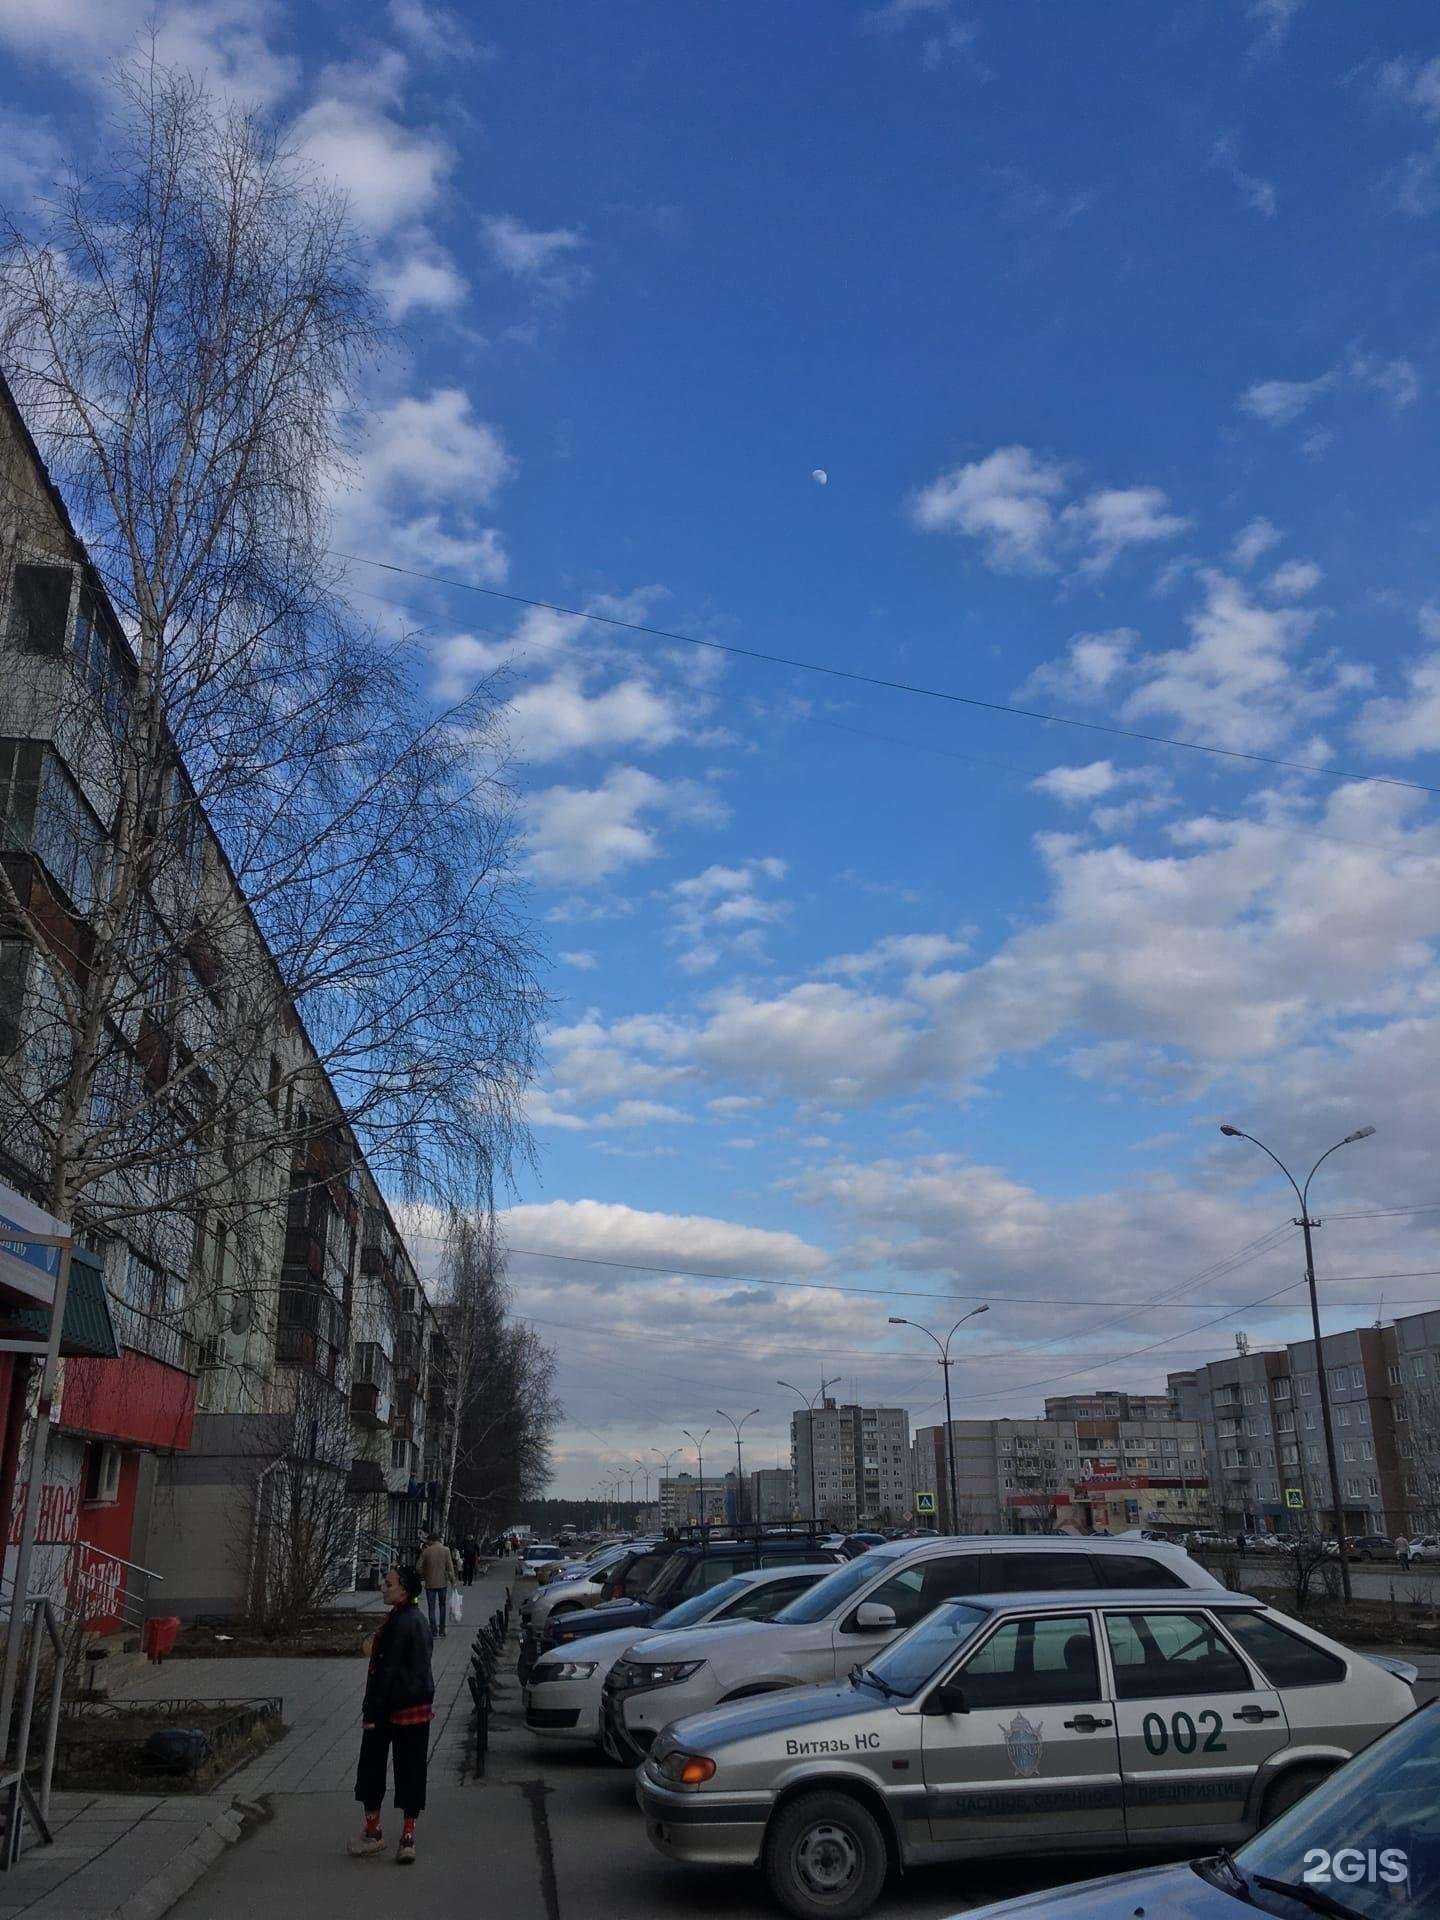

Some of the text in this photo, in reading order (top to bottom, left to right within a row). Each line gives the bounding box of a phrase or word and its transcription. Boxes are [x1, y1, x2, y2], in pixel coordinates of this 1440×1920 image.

[786, 1732, 880, 1755] Витязь НС
[1143, 1709, 1227, 1755] 002
